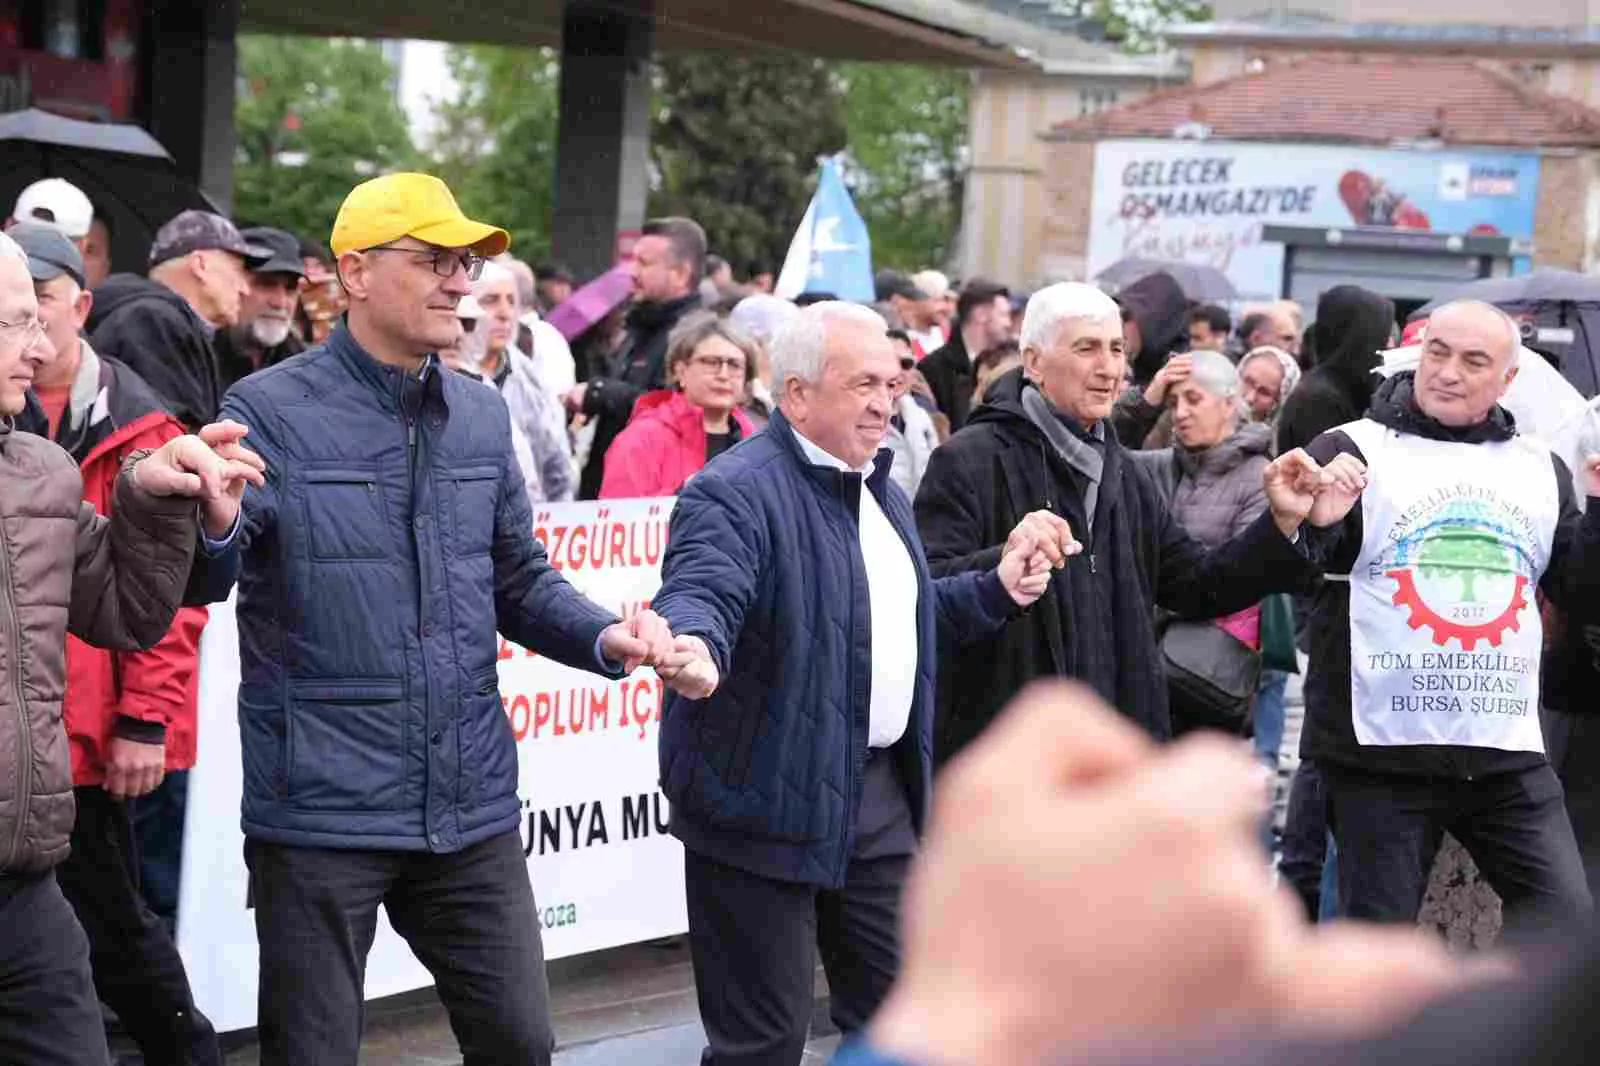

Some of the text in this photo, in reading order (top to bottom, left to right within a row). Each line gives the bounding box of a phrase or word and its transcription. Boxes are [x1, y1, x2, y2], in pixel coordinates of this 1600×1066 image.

[1121, 157, 1235, 188] GELECEK
[534, 504, 670, 571] ÖZGÜRLÜ
[1453, 606, 1486, 619] 2017
[1368, 651, 1412, 670] TÜM
[501, 683, 609, 742] OPLUM
[1391, 695, 1464, 713] BURSA
[538, 902, 577, 929] oza
